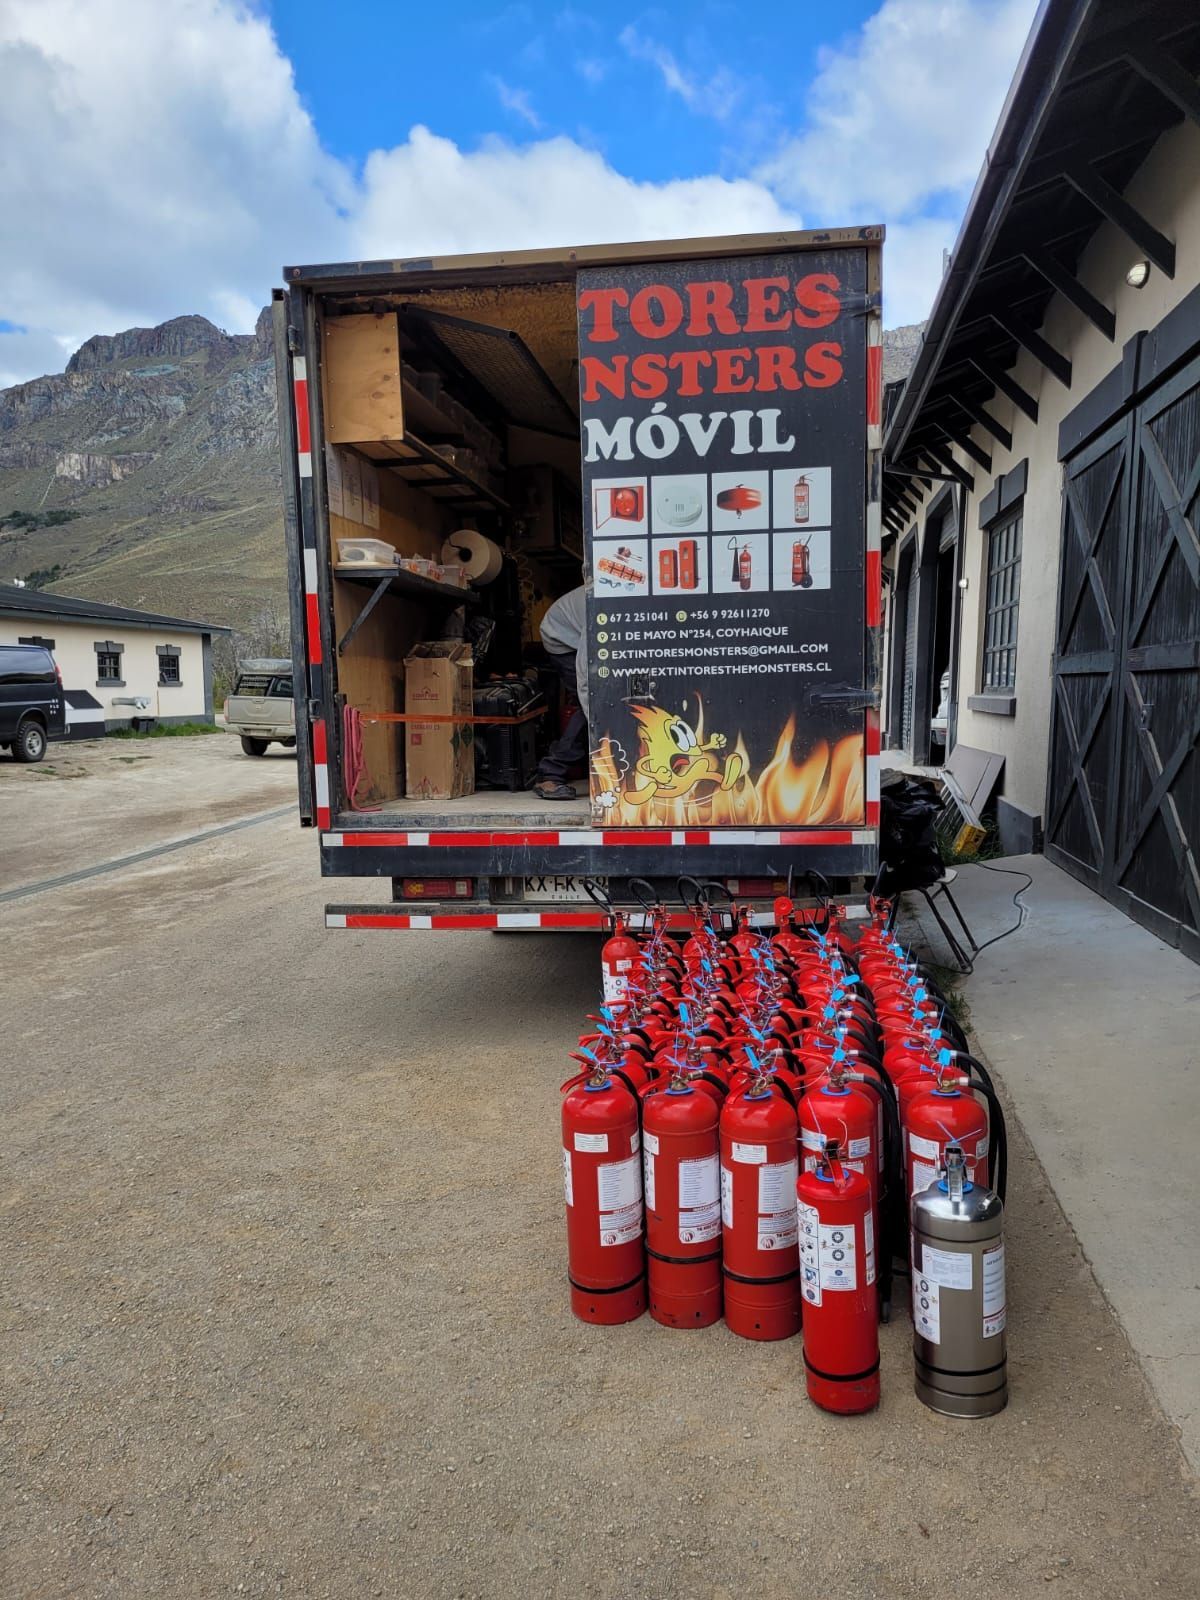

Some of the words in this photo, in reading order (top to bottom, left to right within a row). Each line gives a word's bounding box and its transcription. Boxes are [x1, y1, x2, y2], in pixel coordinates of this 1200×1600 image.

[577, 273, 842, 343] TORES
[581, 342, 844, 402] NSTERS
[583, 401, 796, 463] MÓVIL
[610, 613, 622, 623] 67
[624, 613, 631, 622] 2
[633, 612, 669, 622] 251041
[690, 611, 709, 620] +56
[712, 610, 718, 619] 9
[721, 608, 770, 619] 92611270
[610, 632, 621, 641] 21
[625, 631, 641, 640] DE
[643, 630, 677, 640] MAYO
[716, 626, 789, 638] COYHAIQUE
[611, 643, 829, 660] EXTINTORESMONSTERS@GMAIL.COM
[612, 662, 832, 678] WWW.EXTINTORESTHEMONSTERS.CL
